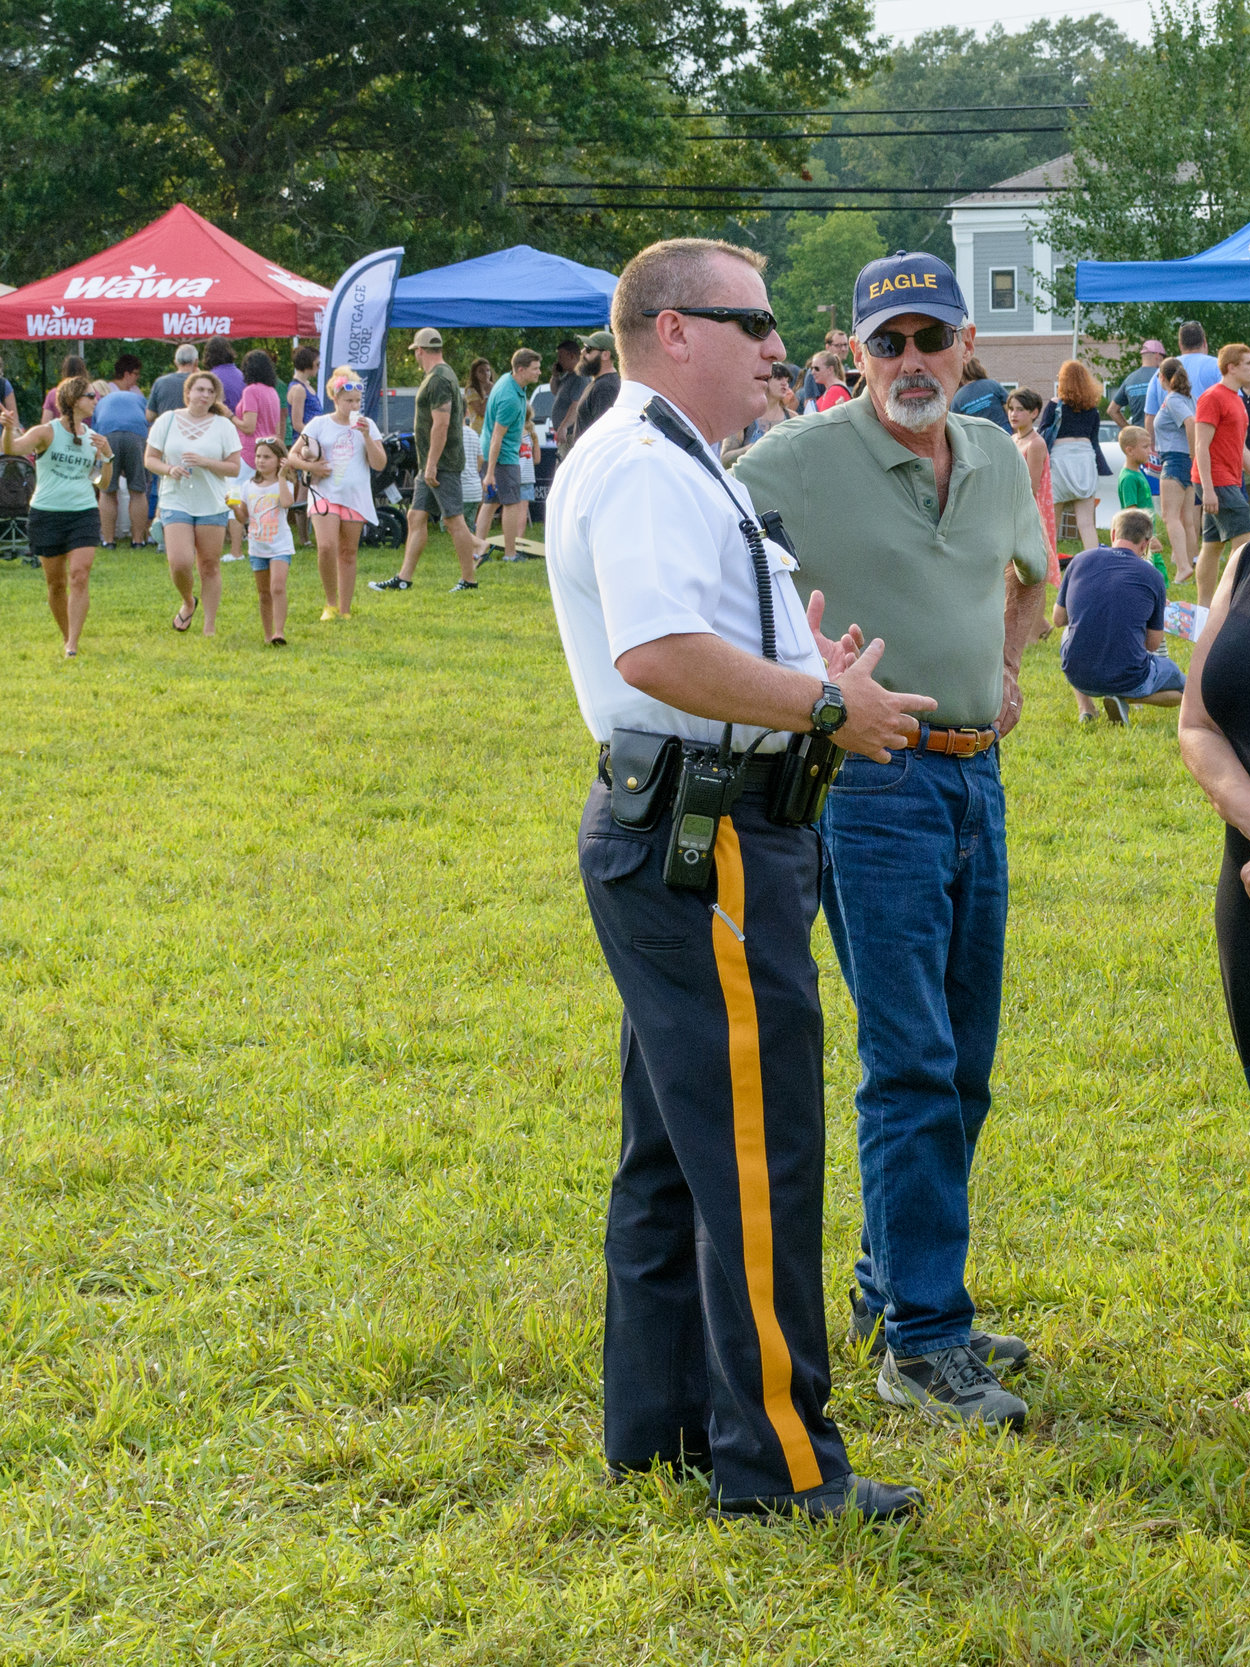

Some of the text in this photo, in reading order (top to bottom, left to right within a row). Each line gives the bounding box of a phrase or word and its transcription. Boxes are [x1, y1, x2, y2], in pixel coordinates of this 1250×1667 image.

[63, 275, 214, 300] Wawa
[869, 273, 938, 300] EAGLE
[26, 313, 95, 337] Wawa
[162, 312, 233, 335] Wawa
[348, 284, 367, 365] MORTGAGE
[359, 326, 374, 365] CORP.
